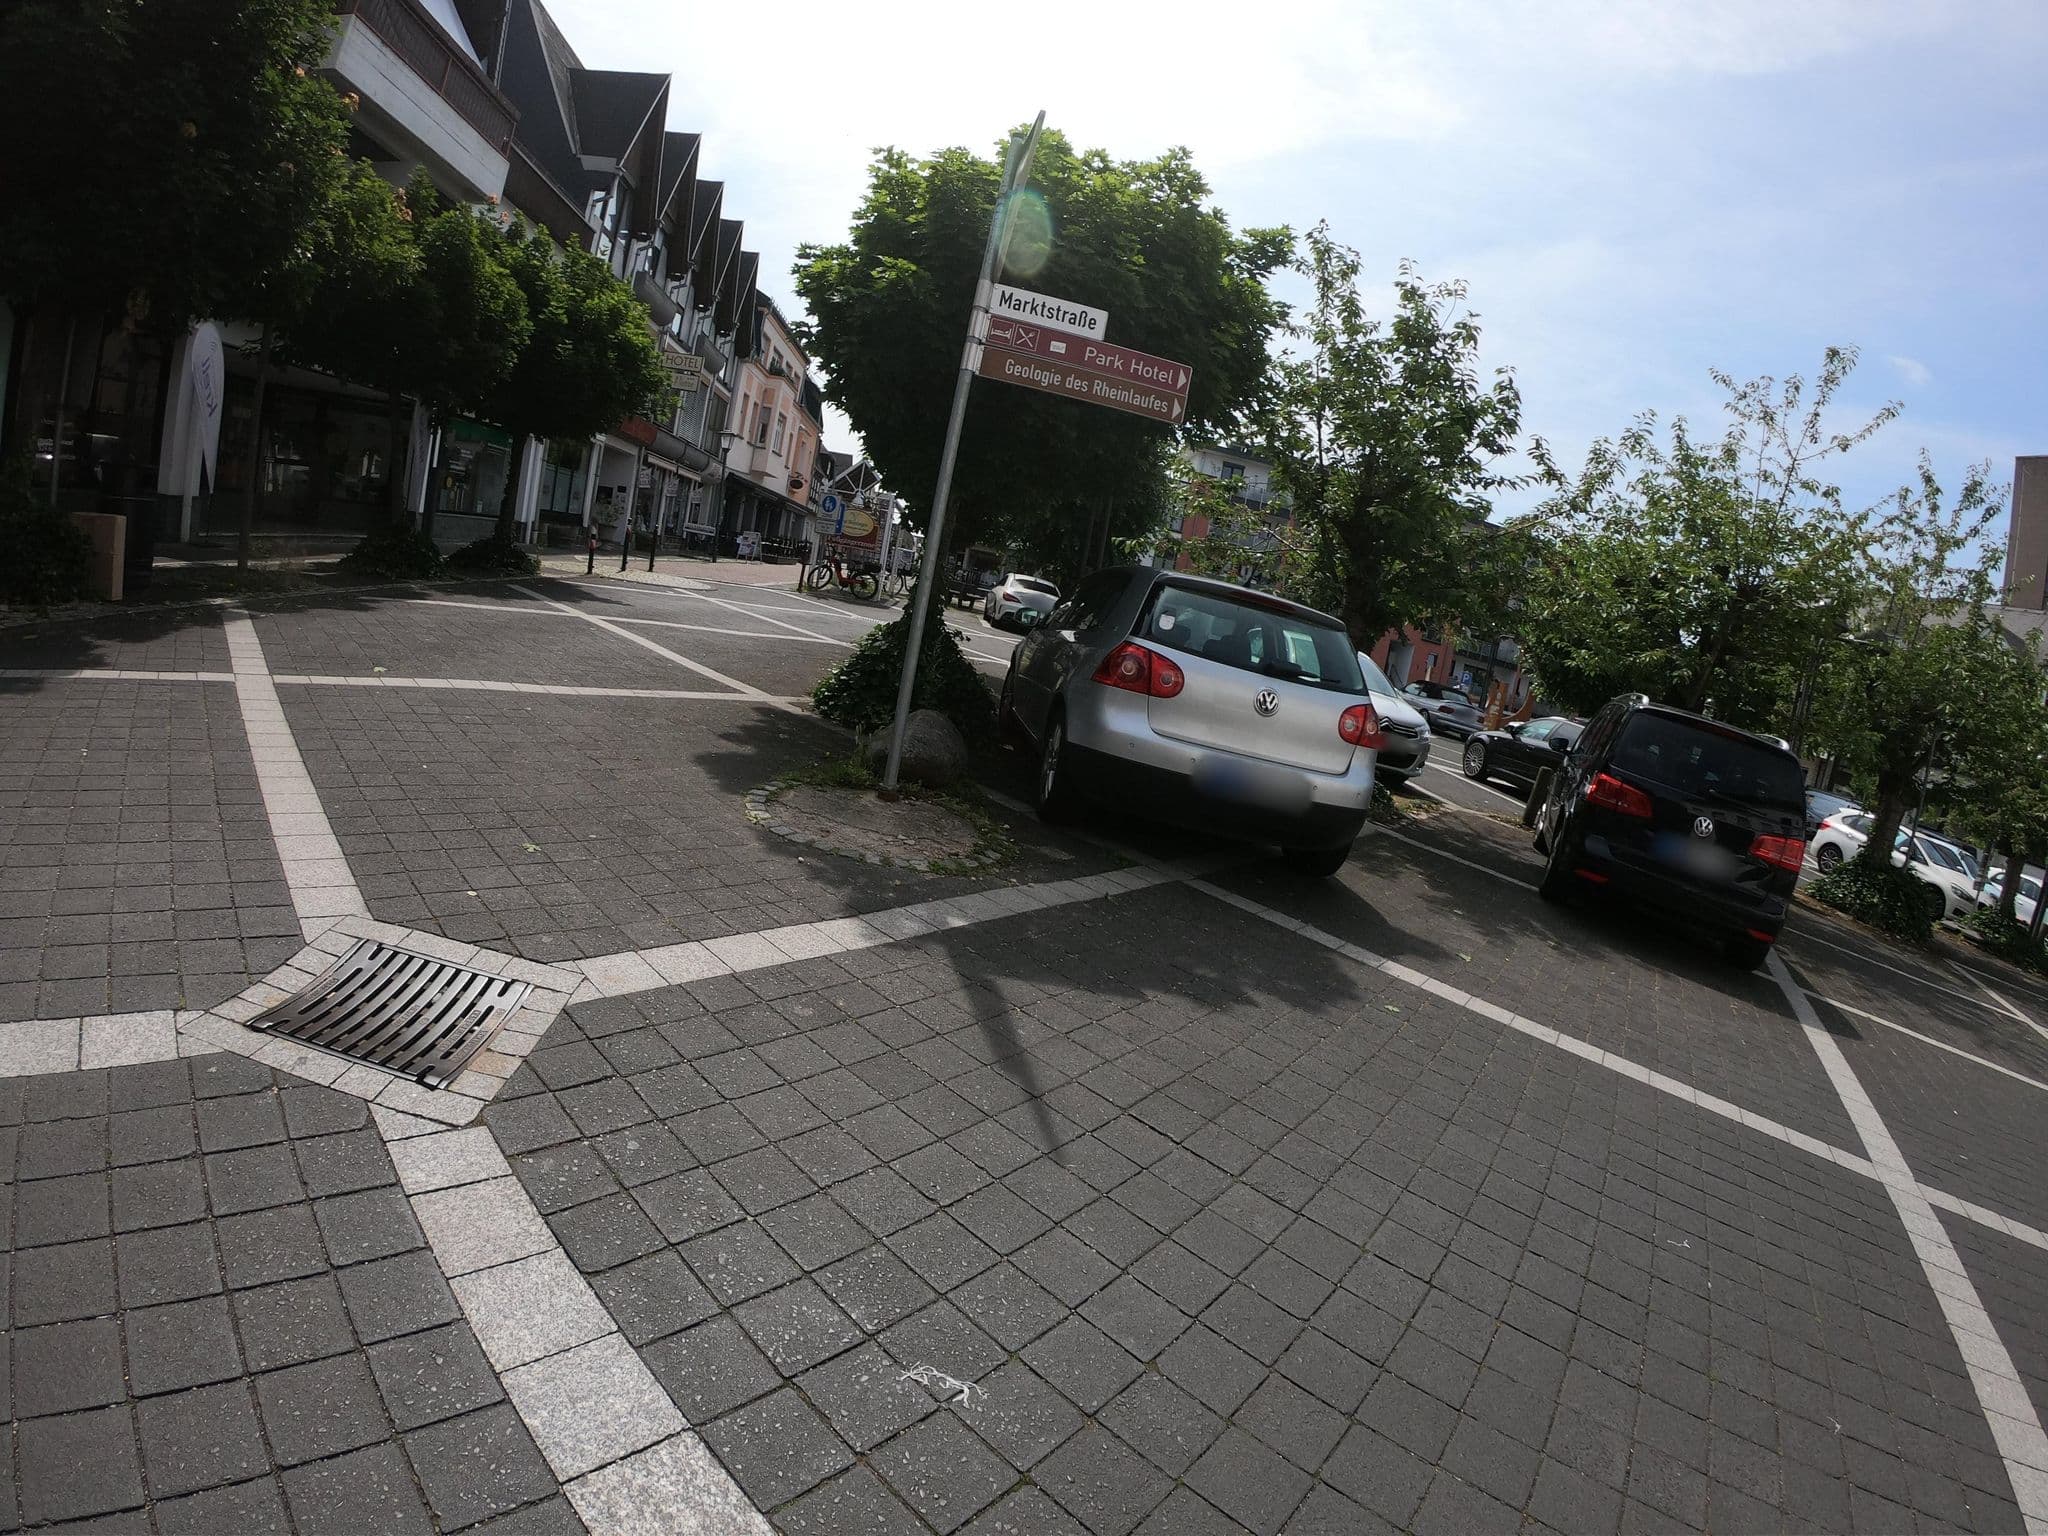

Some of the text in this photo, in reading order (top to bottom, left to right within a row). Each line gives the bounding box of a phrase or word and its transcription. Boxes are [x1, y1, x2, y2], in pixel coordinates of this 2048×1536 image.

[999, 290, 1097, 330] Marktstraße
[665, 354, 699, 369] HOTEL
[1084, 346, 1125, 371] Park
[1130, 358, 1174, 385] Hotel
[1005, 358, 1169, 412] Geologie des Rheinlaufes
